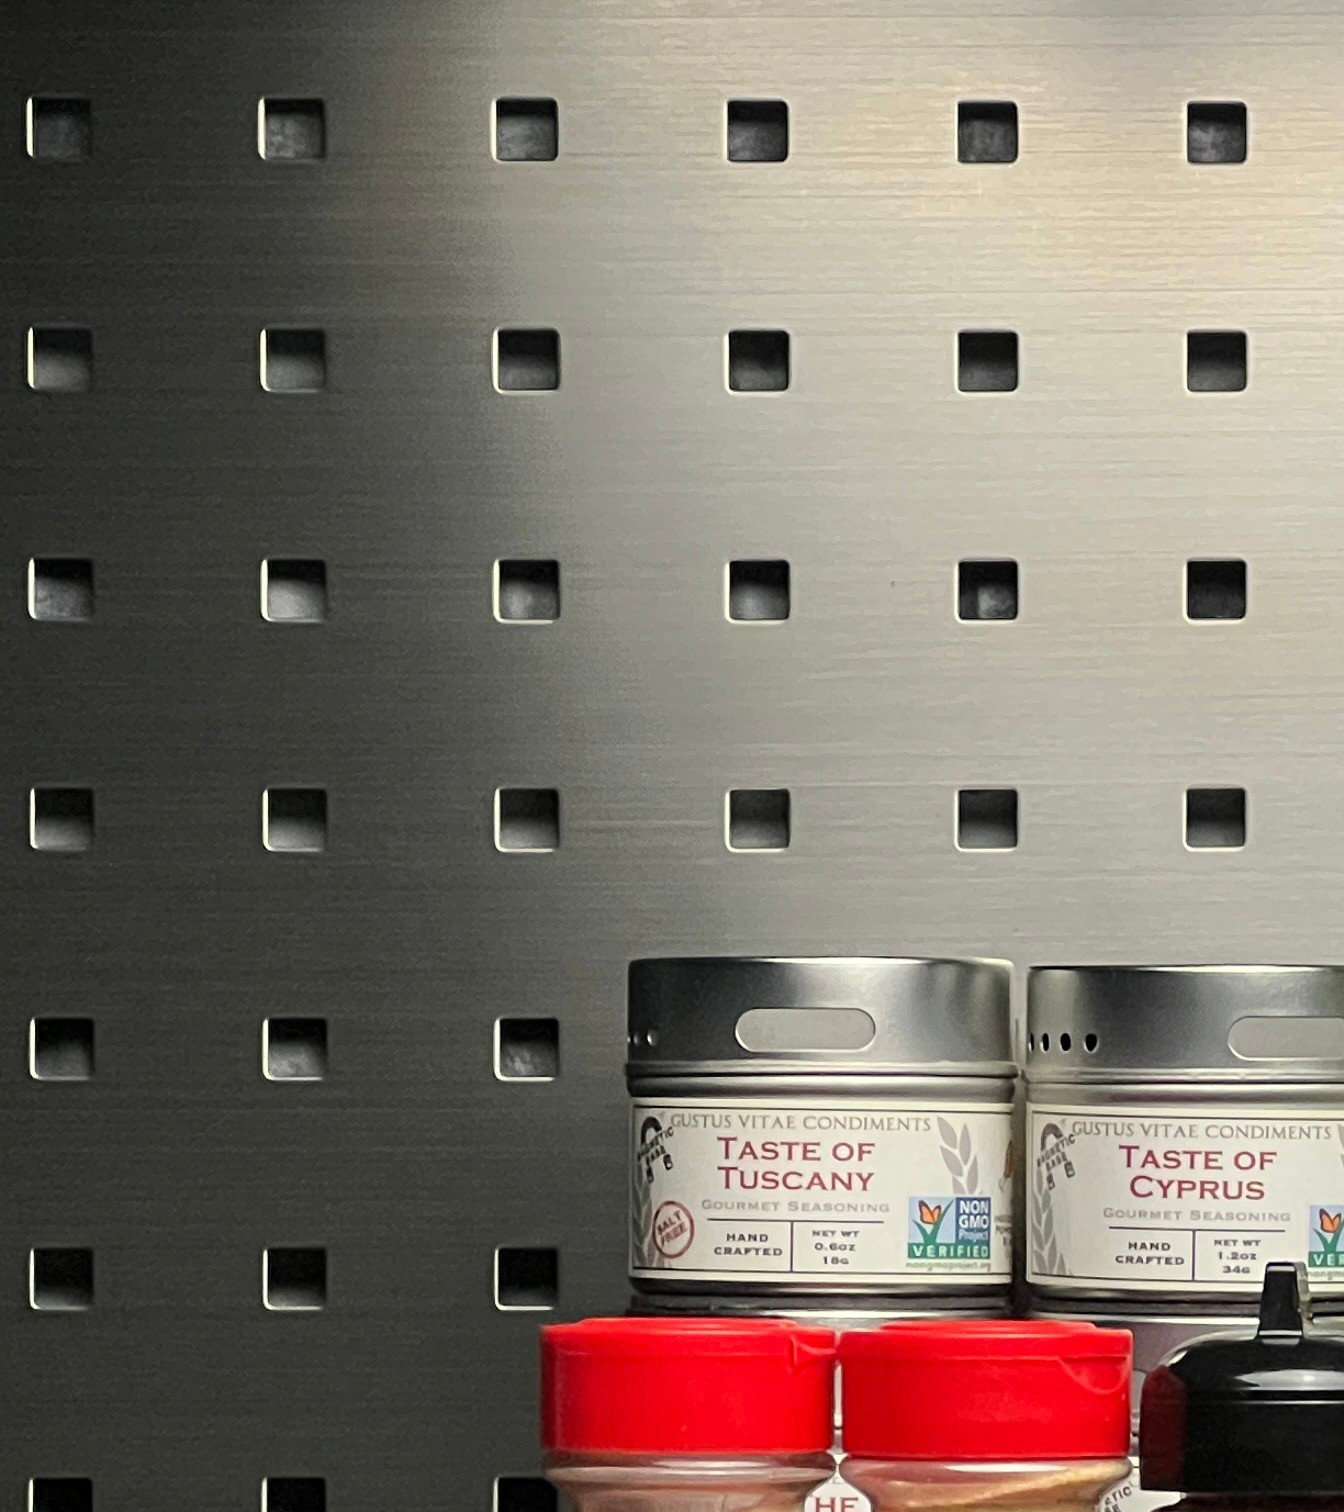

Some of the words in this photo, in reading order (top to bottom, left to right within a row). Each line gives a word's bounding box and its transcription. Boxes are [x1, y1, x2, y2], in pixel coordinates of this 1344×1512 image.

[670, 1113, 733, 1129] GUSTUS
[739, 1114, 797, 1130] VITAE
[803, 1116, 931, 1132] CONDIMENTS
[1072, 1121, 1133, 1136] GUSTUS
[1139, 1123, 1198, 1138] VITAE
[1205, 1124, 1332, 1140] CONDIMENTS
[717, 1136, 821, 1161] TASTE
[832, 1142, 876, 1161] OF
[1119, 1145, 1223, 1170] TASTE
[1233, 1151, 1277, 1170] OF
[717, 1166, 875, 1191] TUSCANY
[1129, 1175, 1265, 1200] CYPRUS
[701, 1199, 780, 1212] GOURMET
[787, 1200, 890, 1213] SEASONING
[959, 1200, 989, 1214] NON
[1103, 1207, 1182, 1220] GOURMET
[1189, 1208, 1291, 1222] SEASONING
[958, 1215, 989, 1229] GMO
[726, 1233, 769, 1242] HAND
[714, 1246, 783, 1256] CRAFTED
[912, 1245, 990, 1259] VERIFIED
[1128, 1241, 1171, 1251] HAND
[1115, 1254, 1185, 1265] CRAFTED
